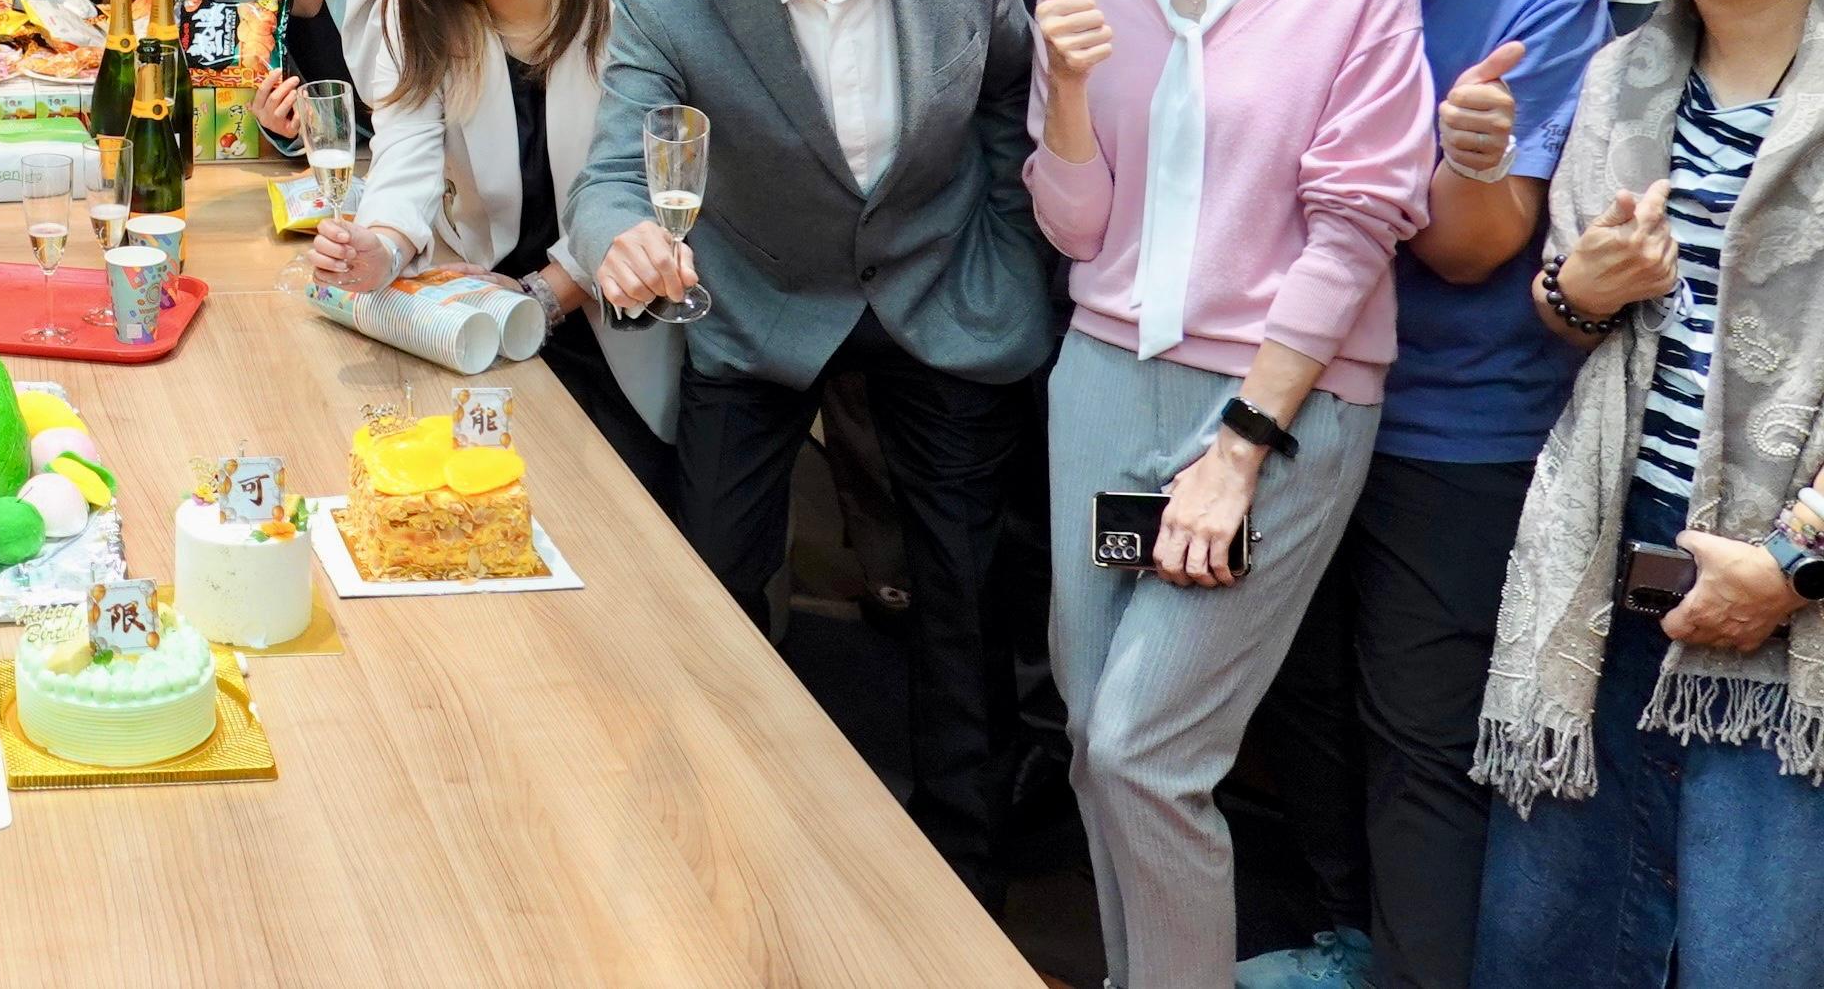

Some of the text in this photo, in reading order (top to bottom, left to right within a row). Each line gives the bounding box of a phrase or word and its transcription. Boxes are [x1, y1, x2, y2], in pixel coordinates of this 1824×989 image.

[469, 403, 498, 435] 能
[238, 473, 270, 507] 可
[105, 600, 146, 633] 限
